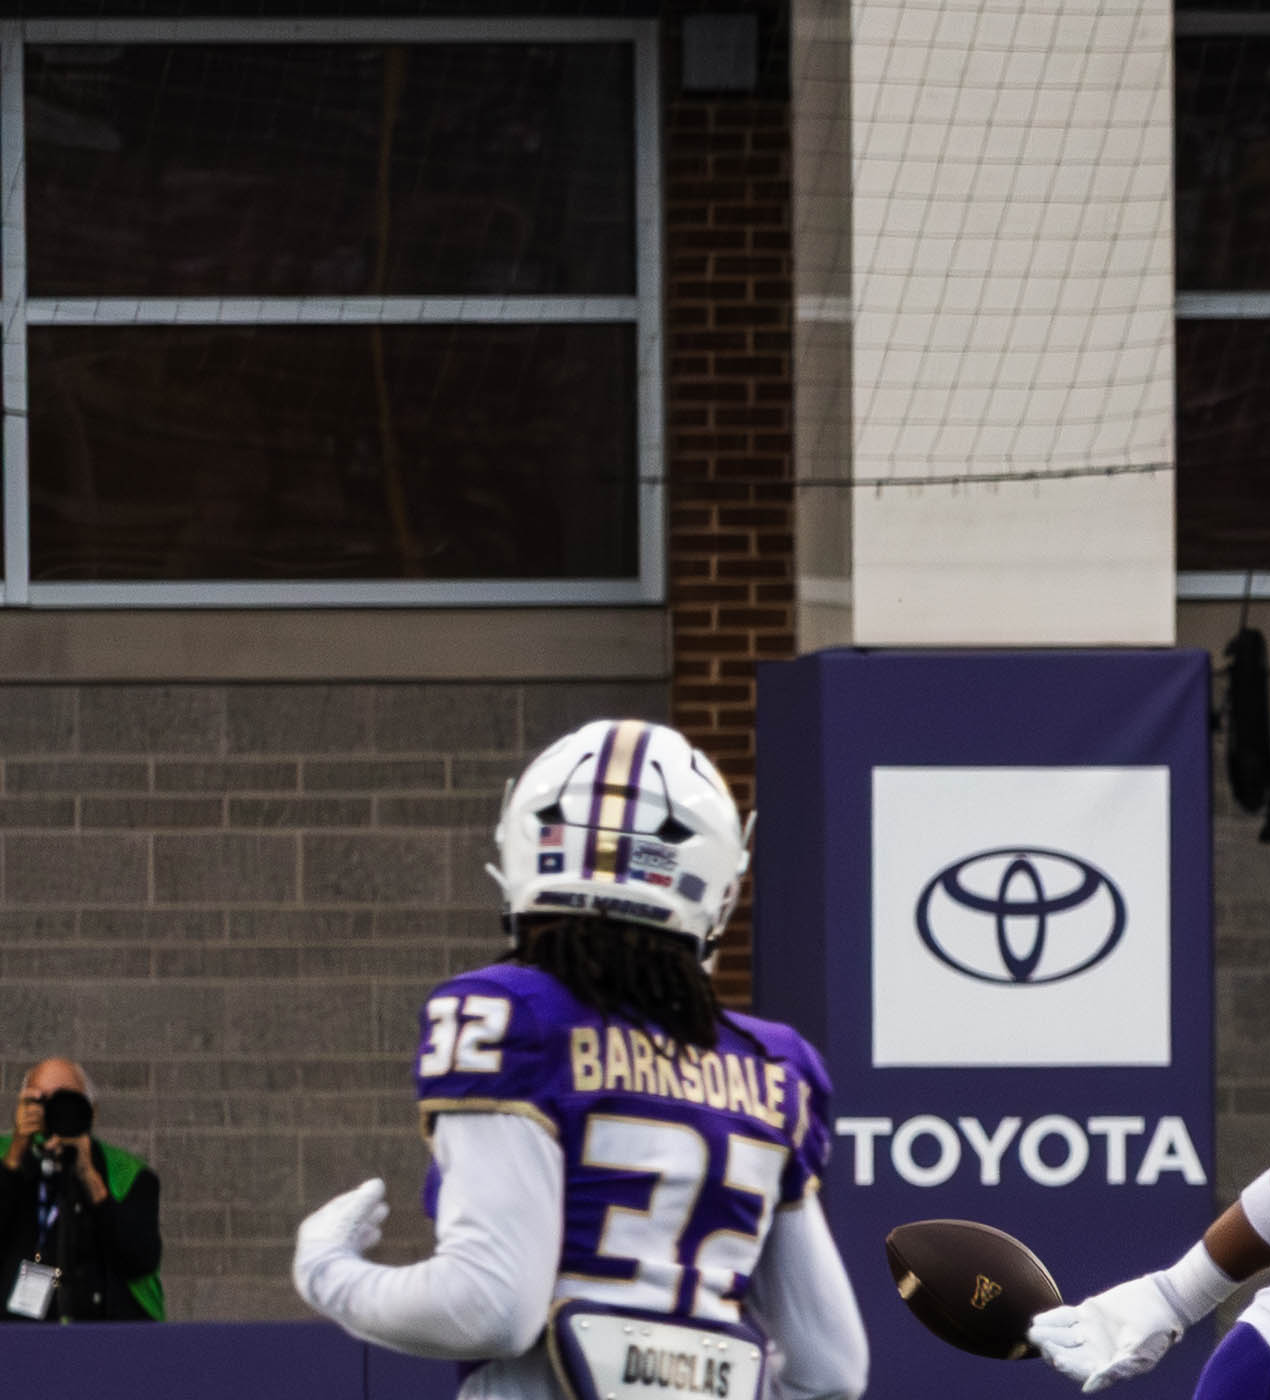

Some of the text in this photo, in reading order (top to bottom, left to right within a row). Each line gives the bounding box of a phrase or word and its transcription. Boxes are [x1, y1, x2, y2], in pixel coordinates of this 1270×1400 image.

[420, 995, 513, 1077] 32
[835, 1114, 1208, 1187] TOYOTA
[552, 1111, 790, 1326] 32
[621, 1343, 732, 1399] DOUGLAS
